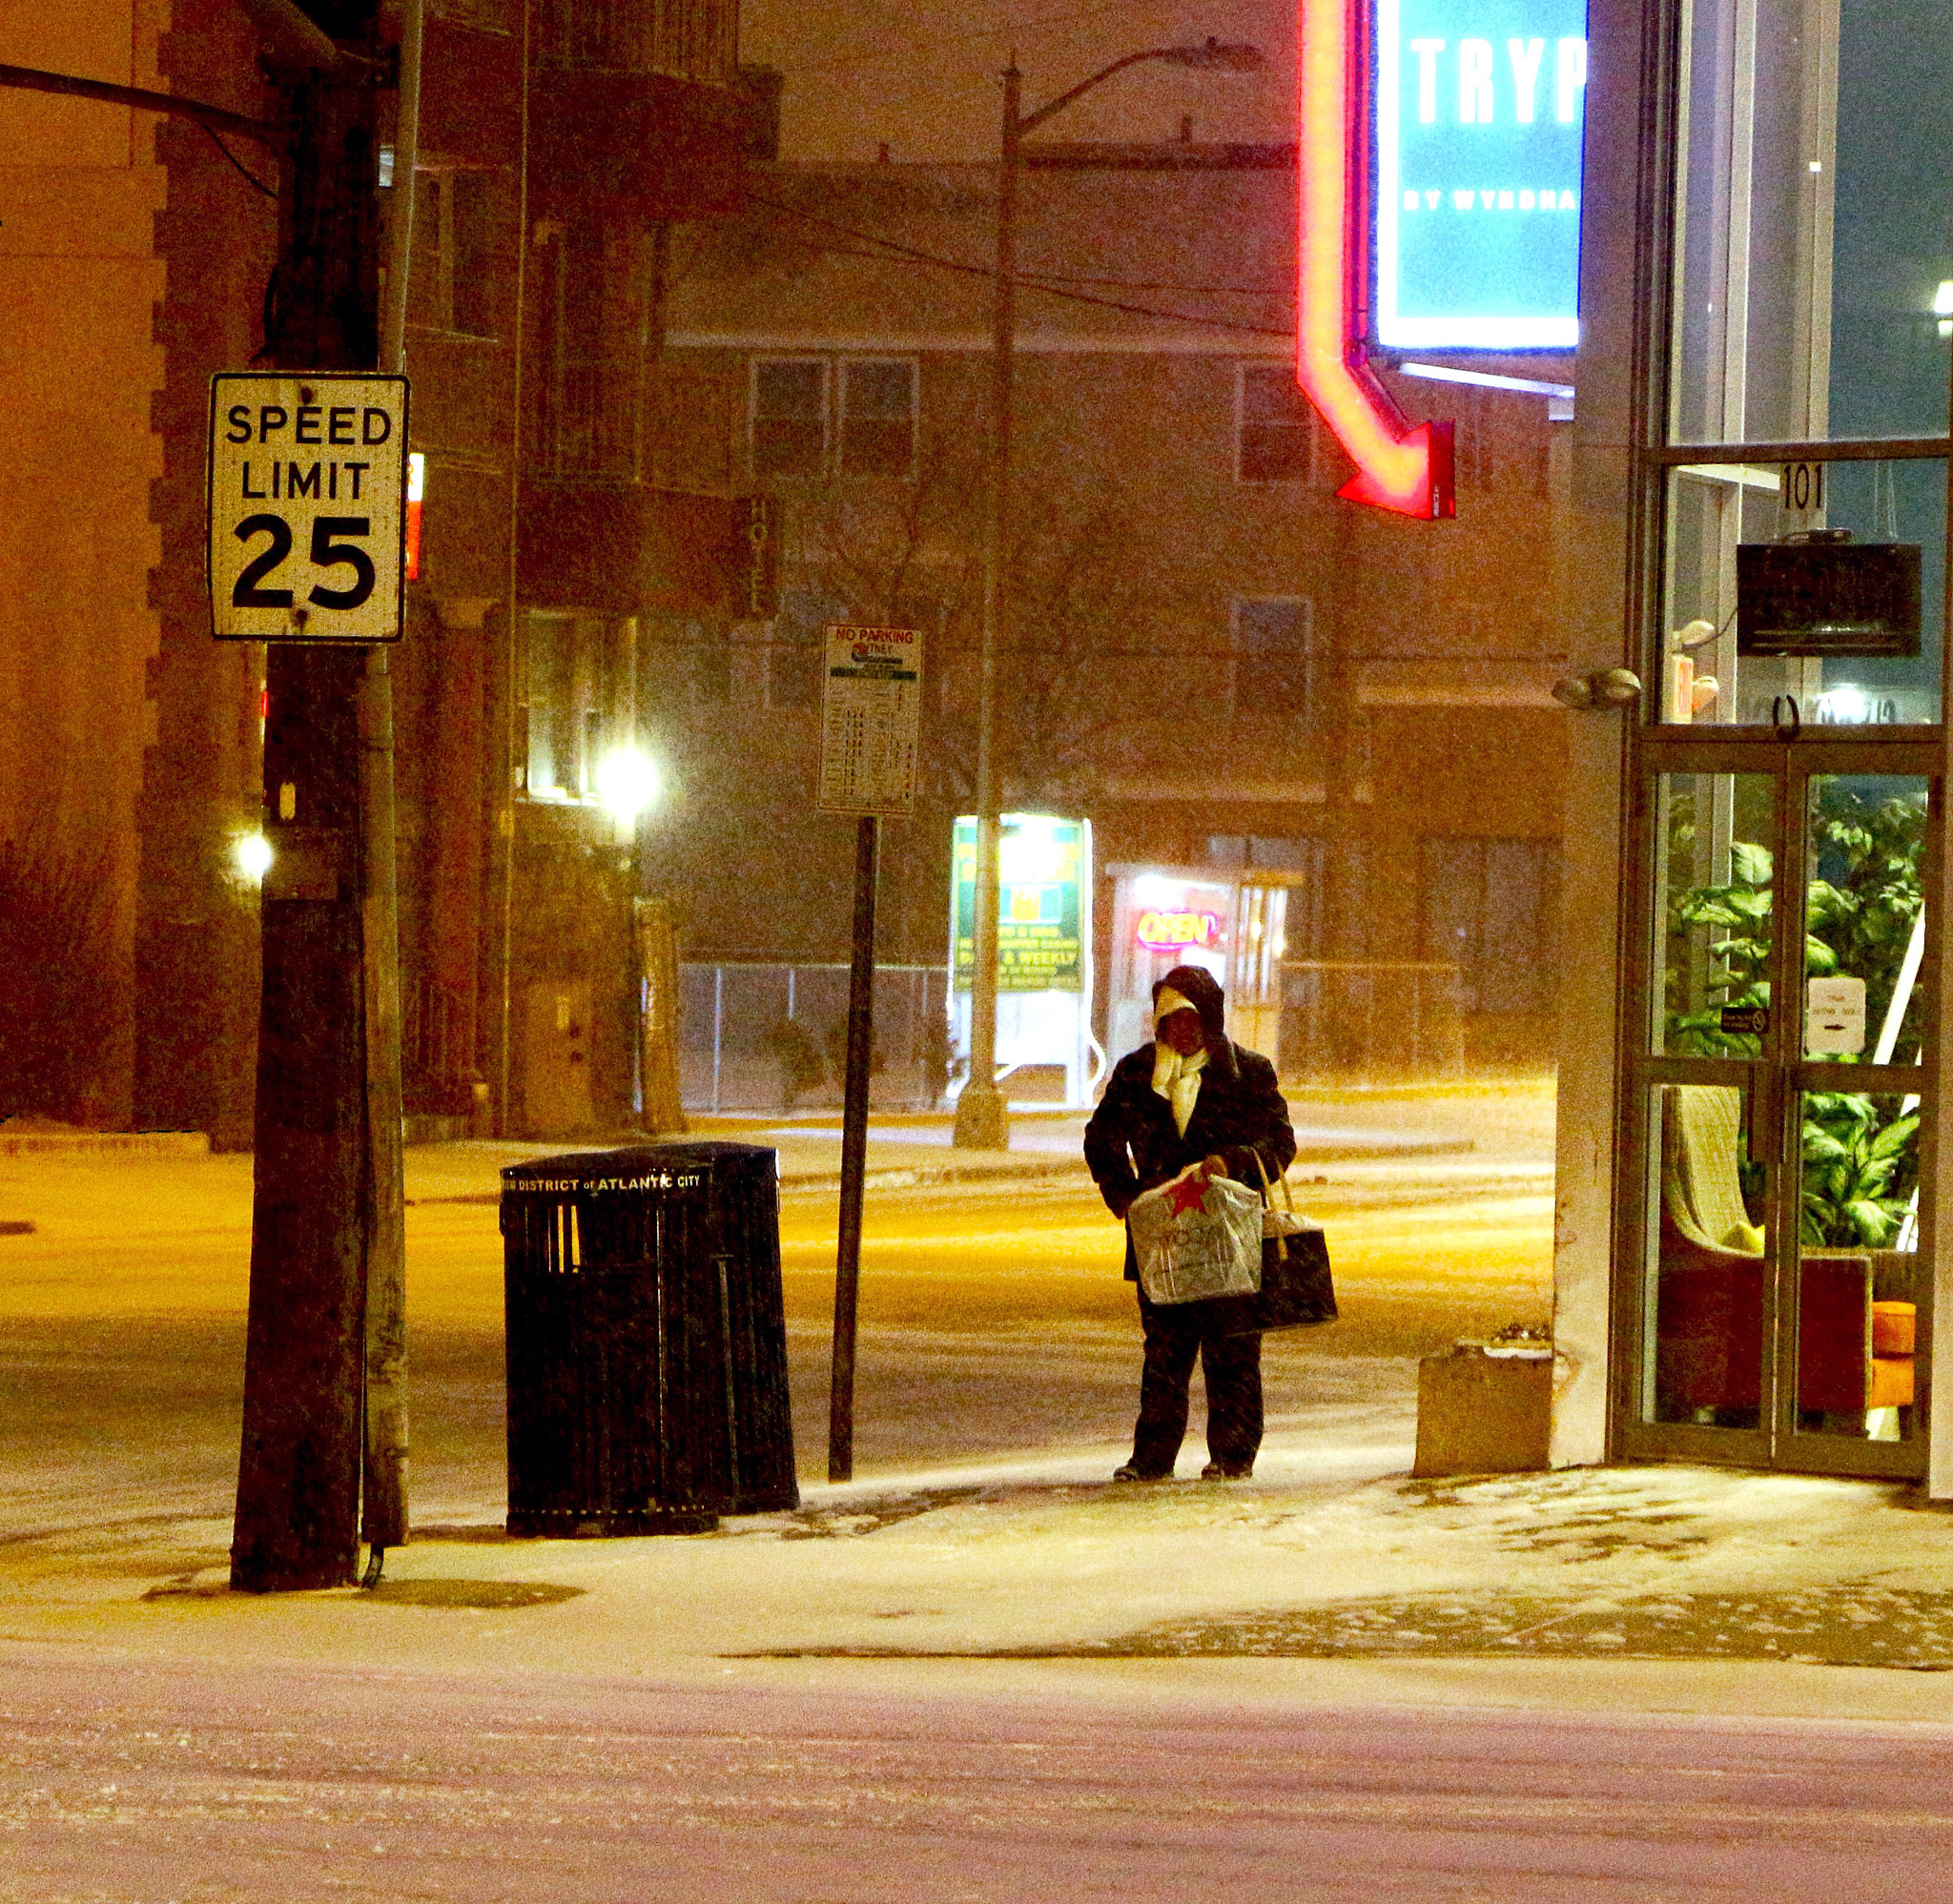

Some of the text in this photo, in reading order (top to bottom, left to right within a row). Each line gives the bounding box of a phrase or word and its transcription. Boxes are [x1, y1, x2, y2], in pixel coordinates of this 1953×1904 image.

[1410, 37, 1588, 123] TRYP
[1404, 190, 1441, 210] BY
[226, 404, 391, 445] SPEED
[241, 461, 370, 500] LIMIT
[1783, 463, 1823, 510] 101
[232, 513, 377, 610] 25
[835, 628, 914, 644] NO PARKING
[1138, 912, 1209, 943] OPEN
[518, 1178, 579, 1192] DISTRICT
[598, 1174, 672, 1191] ATLANTIC
[677, 1175, 700, 1188] CITY
